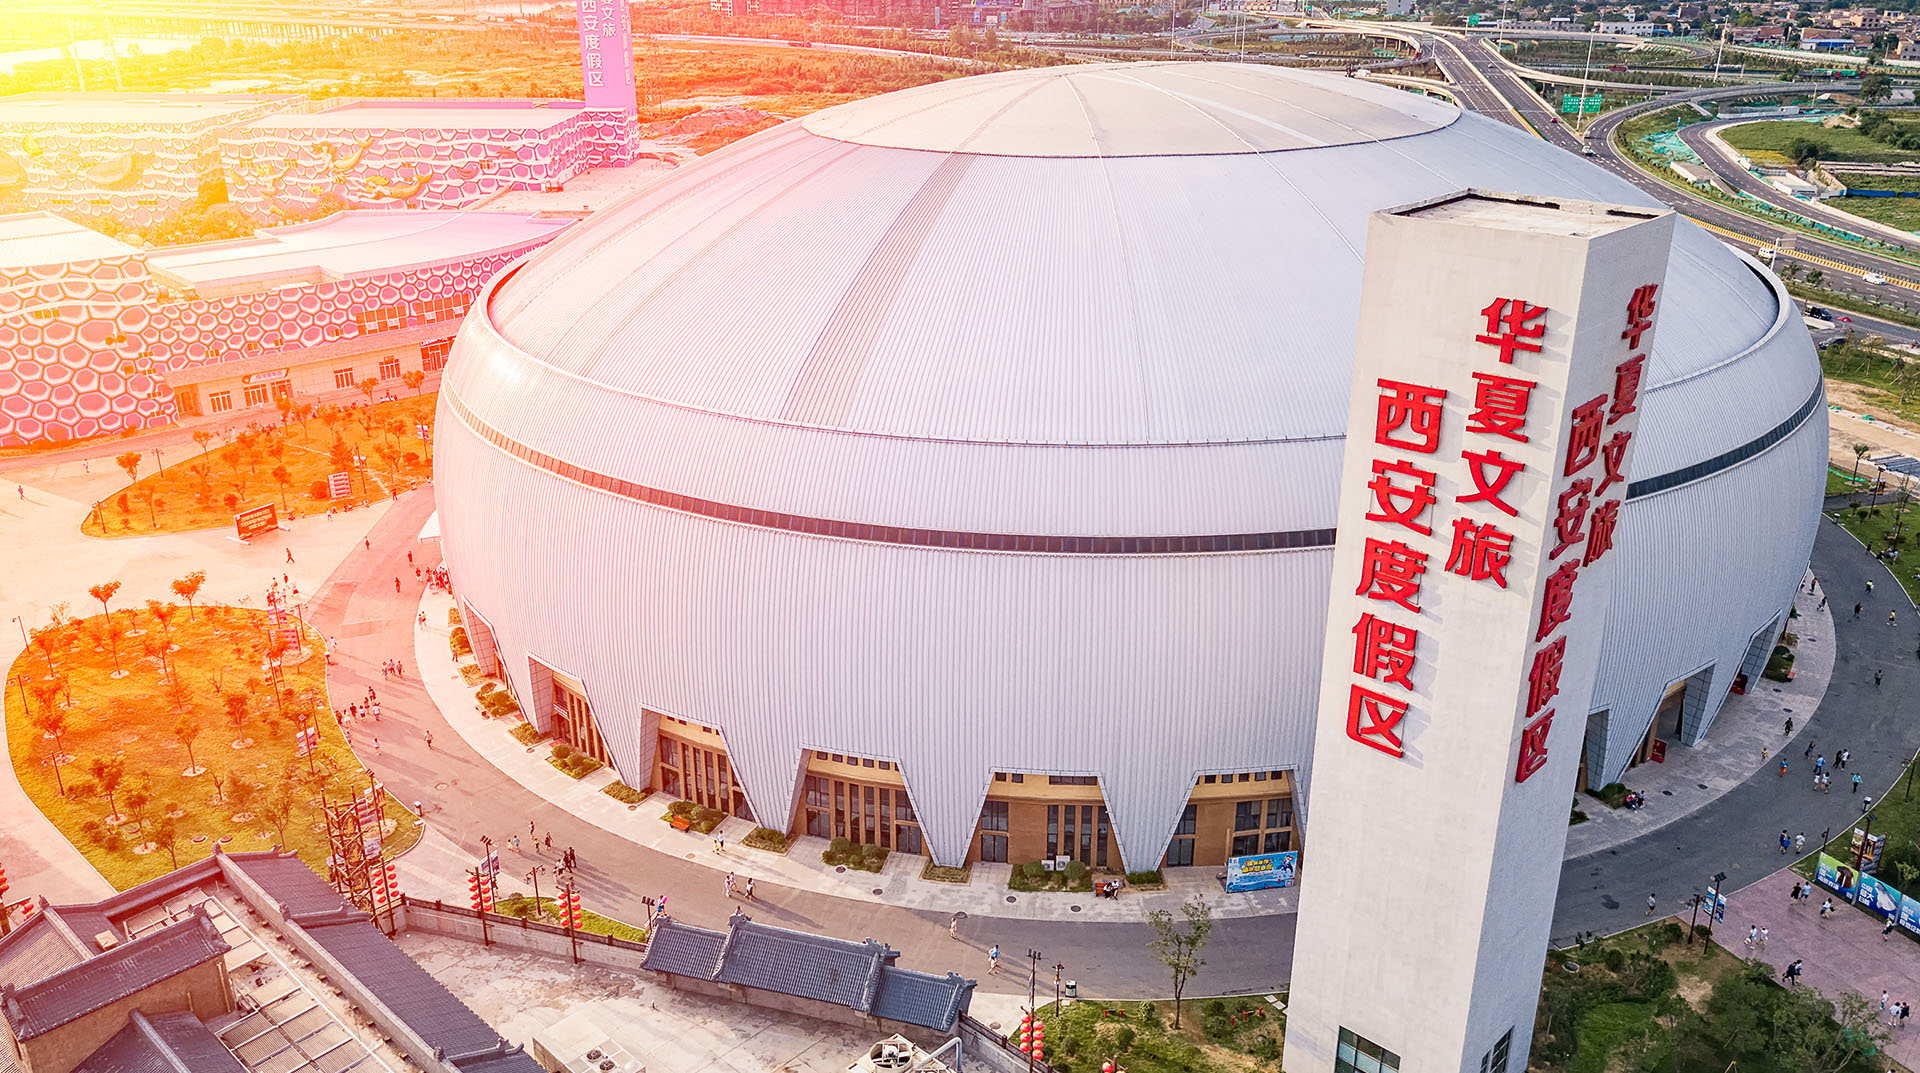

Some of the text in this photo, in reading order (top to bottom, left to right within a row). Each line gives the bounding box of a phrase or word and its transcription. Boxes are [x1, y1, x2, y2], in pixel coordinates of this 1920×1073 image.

[1346, 377, 1448, 759] 西安度假区
[1445, 297, 1549, 589] 华夏文旅
[1515, 393, 1609, 783] 西安度假区
[1583, 283, 1659, 567] 华夏文旅
